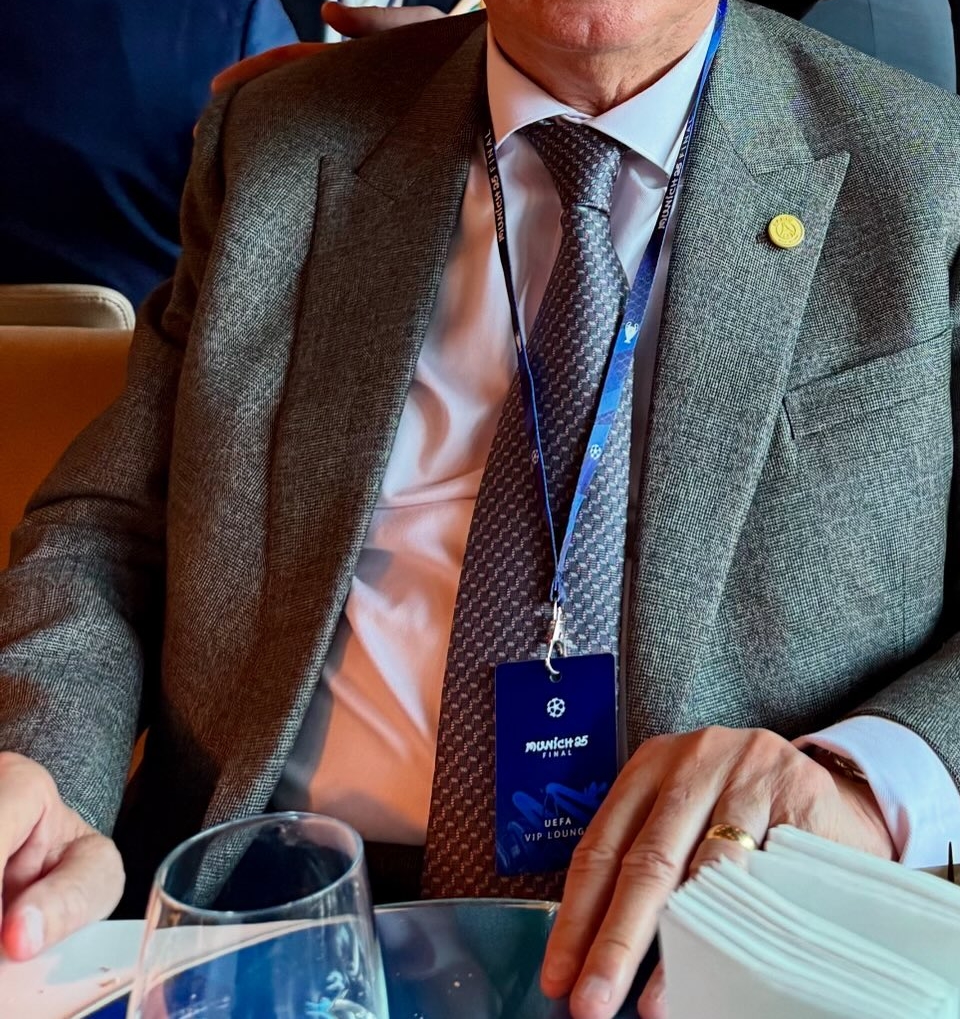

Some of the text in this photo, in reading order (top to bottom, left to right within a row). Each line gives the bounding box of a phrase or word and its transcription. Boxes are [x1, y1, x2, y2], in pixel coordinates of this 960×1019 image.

[484, 129, 497, 173] FINAL
[574, 735, 588, 747] 25
[542, 749, 572, 759] FINAL
[544, 816, 572, 828] UEFA
[524, 827, 585, 842] VIP LOUNG
